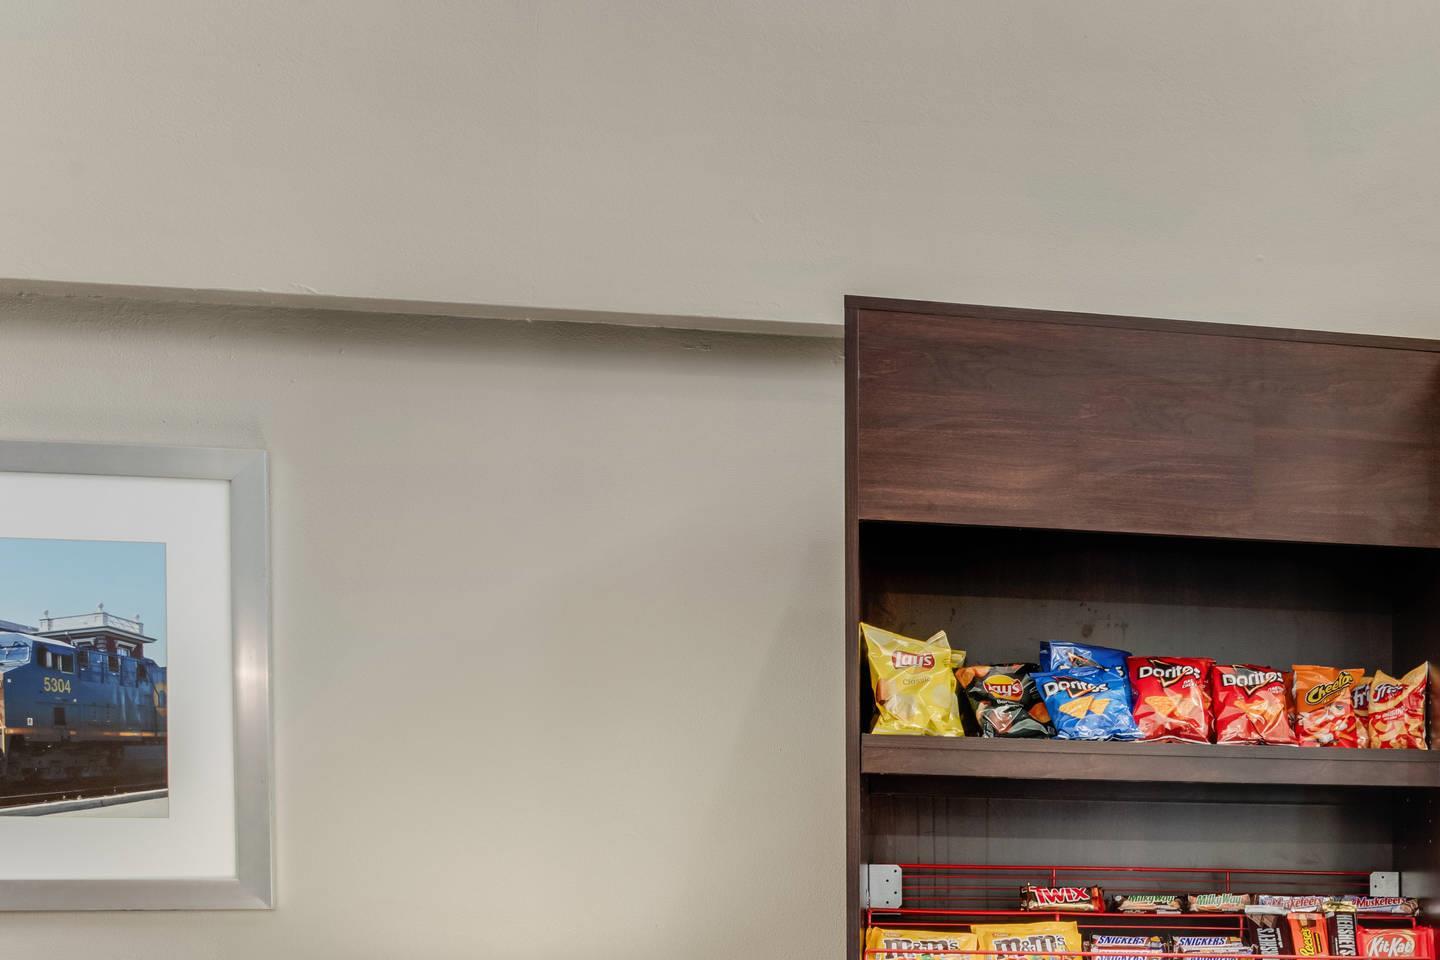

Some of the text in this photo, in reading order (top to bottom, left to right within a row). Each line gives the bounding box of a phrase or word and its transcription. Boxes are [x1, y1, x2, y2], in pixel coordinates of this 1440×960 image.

[1139, 665, 1200, 679] Doritos
[1222, 671, 1283, 687] Doritos
[43, 676, 71, 694] 5304
[1044, 681, 1108, 698] Doritos
[1029, 886, 1090, 906] TWIX
[1097, 935, 1146, 946] SNICKERS
[1178, 936, 1226, 947] SNICKERS
